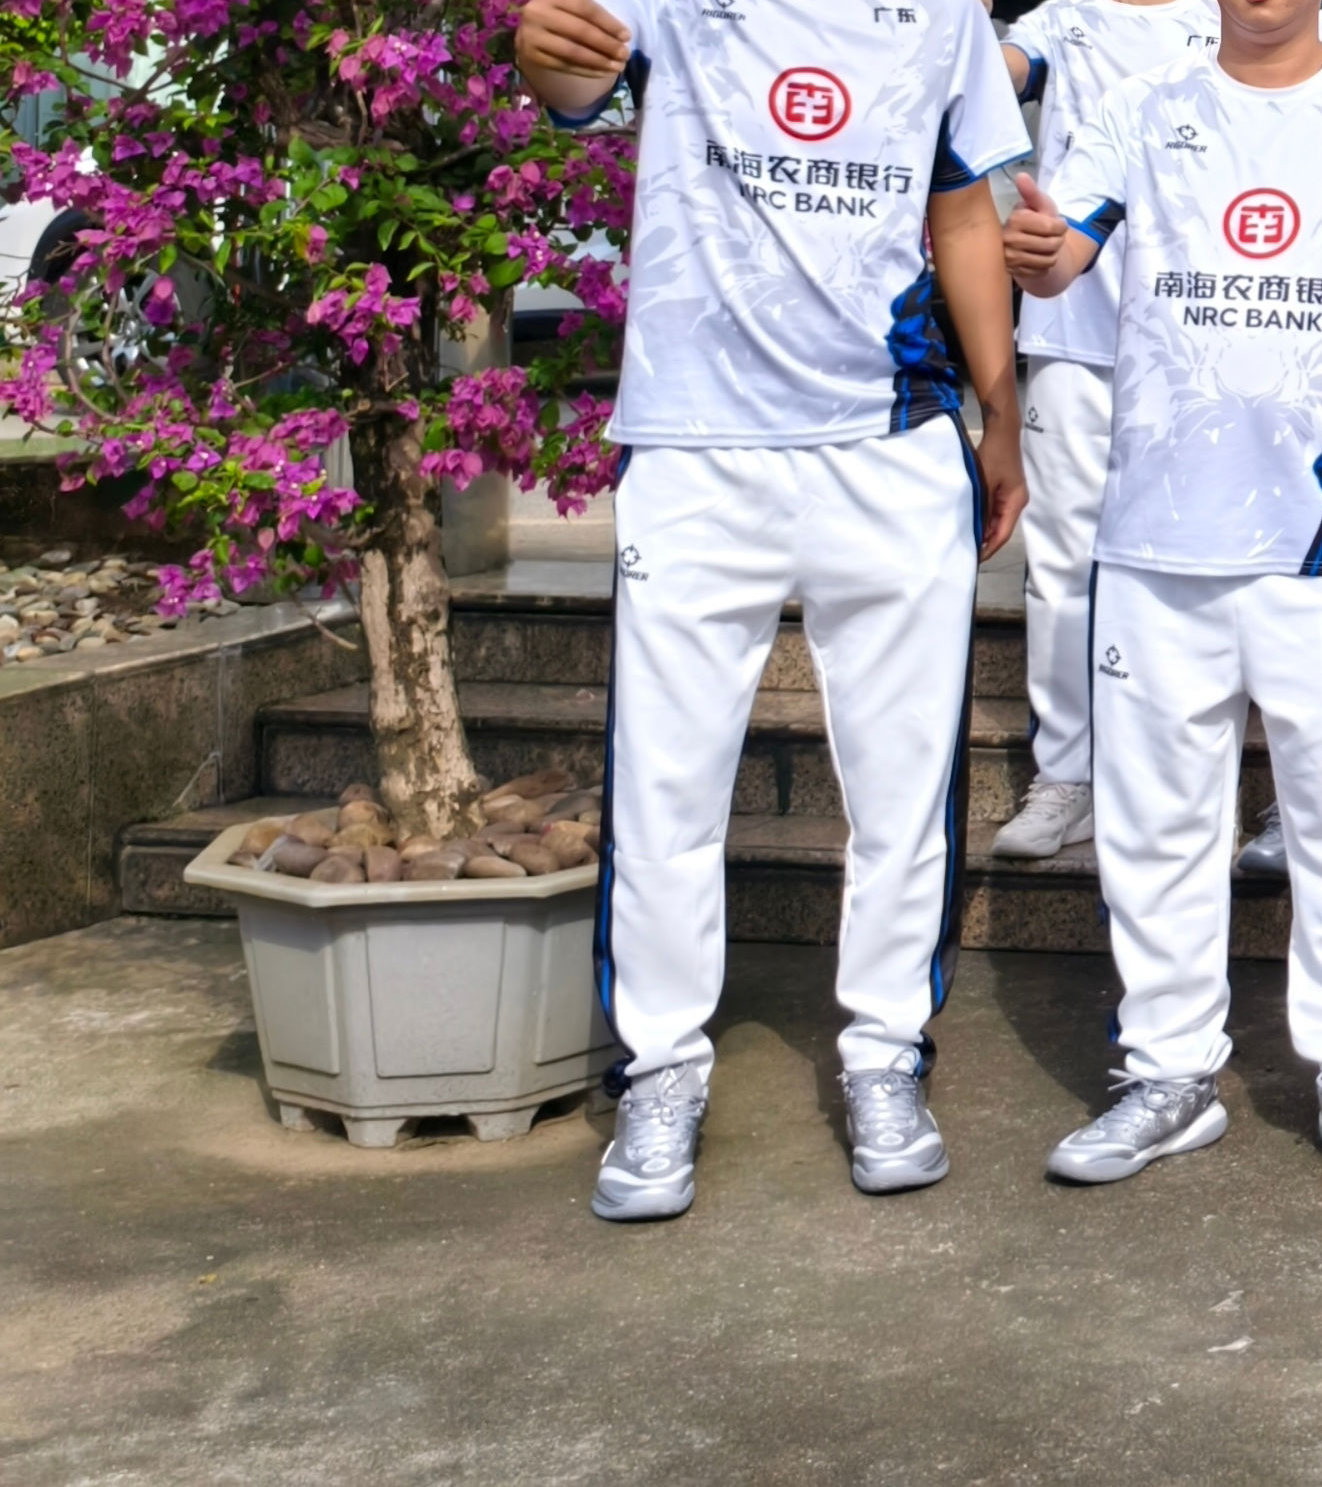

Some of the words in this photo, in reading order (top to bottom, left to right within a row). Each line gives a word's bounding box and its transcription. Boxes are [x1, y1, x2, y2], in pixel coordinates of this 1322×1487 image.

[874, 7, 917, 24] 广东
[795, 190, 878, 219] BANK
[1183, 306, 1239, 329] NRC
[1245, 309, 1322, 333] BANK
